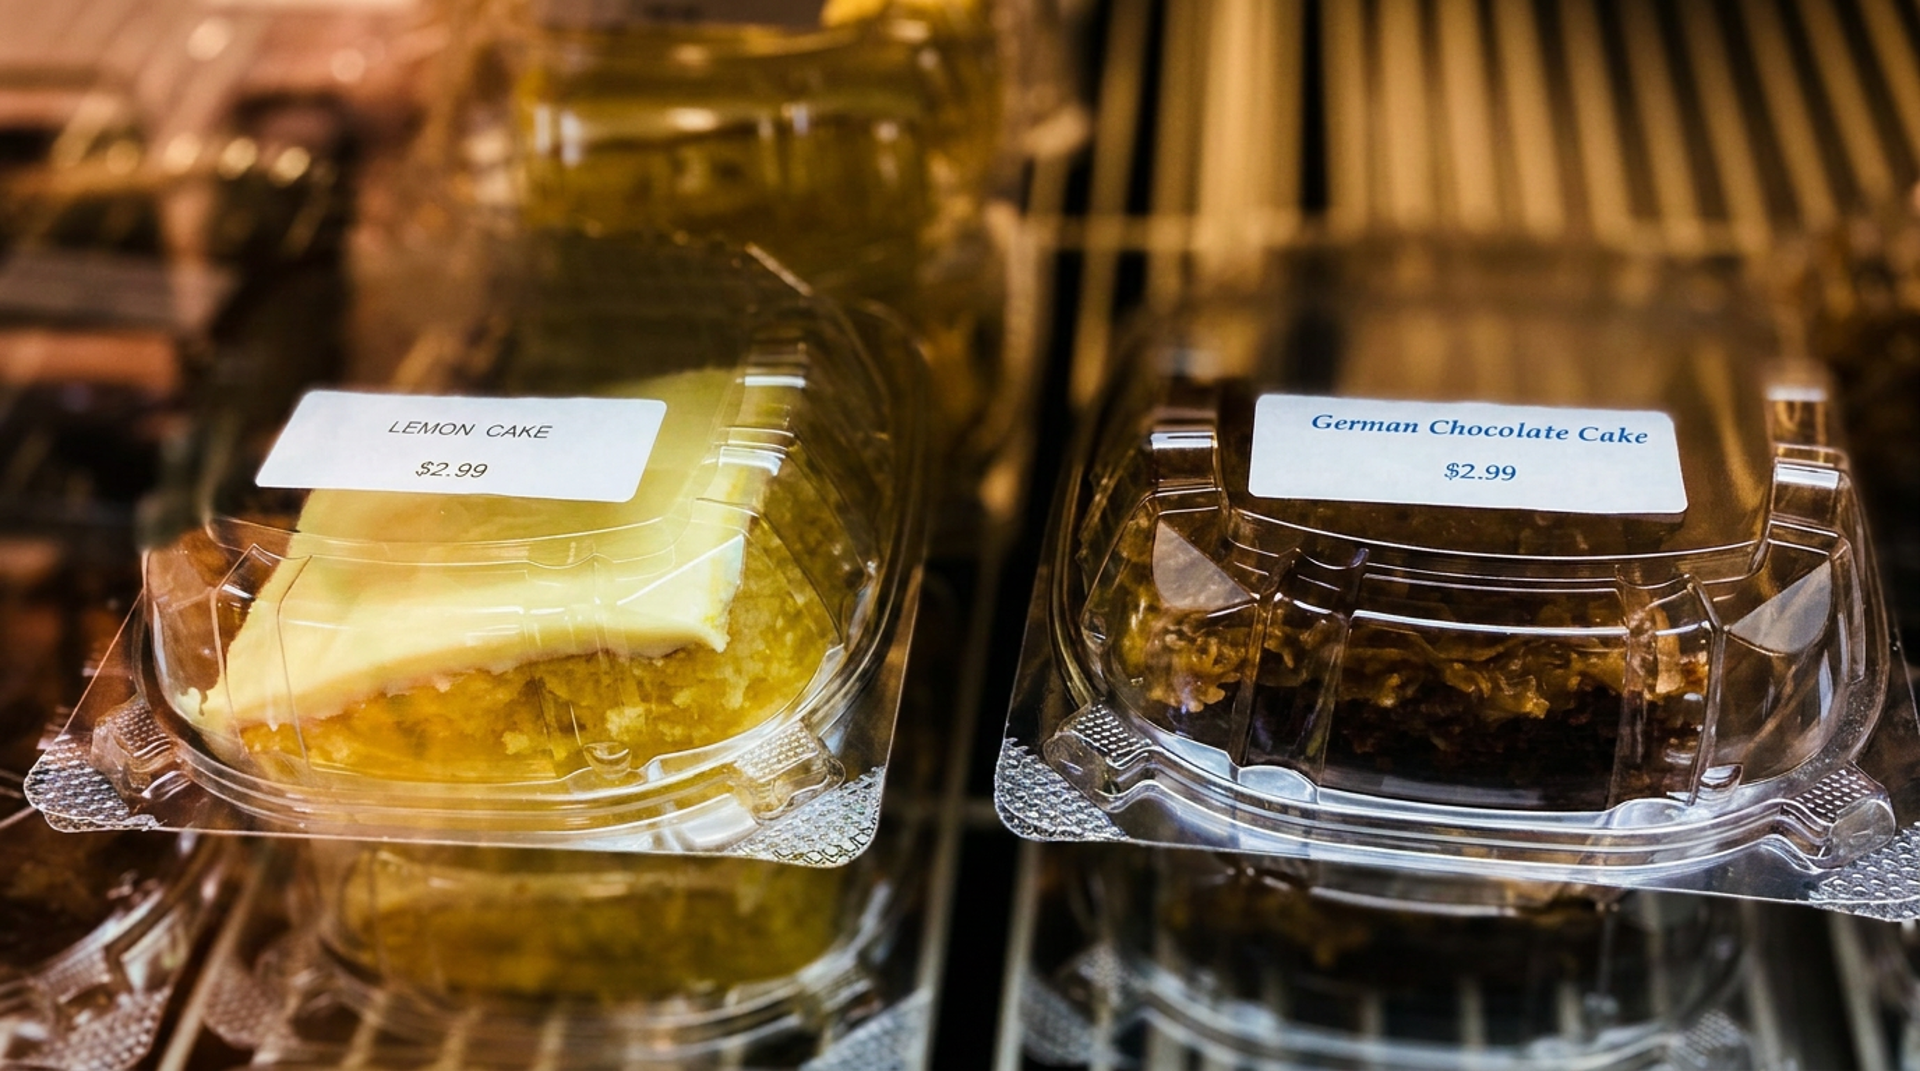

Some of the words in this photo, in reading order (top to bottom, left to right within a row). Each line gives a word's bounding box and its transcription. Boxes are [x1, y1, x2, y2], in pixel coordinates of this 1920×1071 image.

[388, 421, 476, 436] LEMON
[486, 424, 553, 439] CAKE
[1311, 414, 1419, 434] German
[1429, 419, 1569, 440] Chocolate
[1578, 426, 1648, 444] Cake
[415, 460, 488, 478] $2.99
[1444, 462, 1517, 482] $2.99
